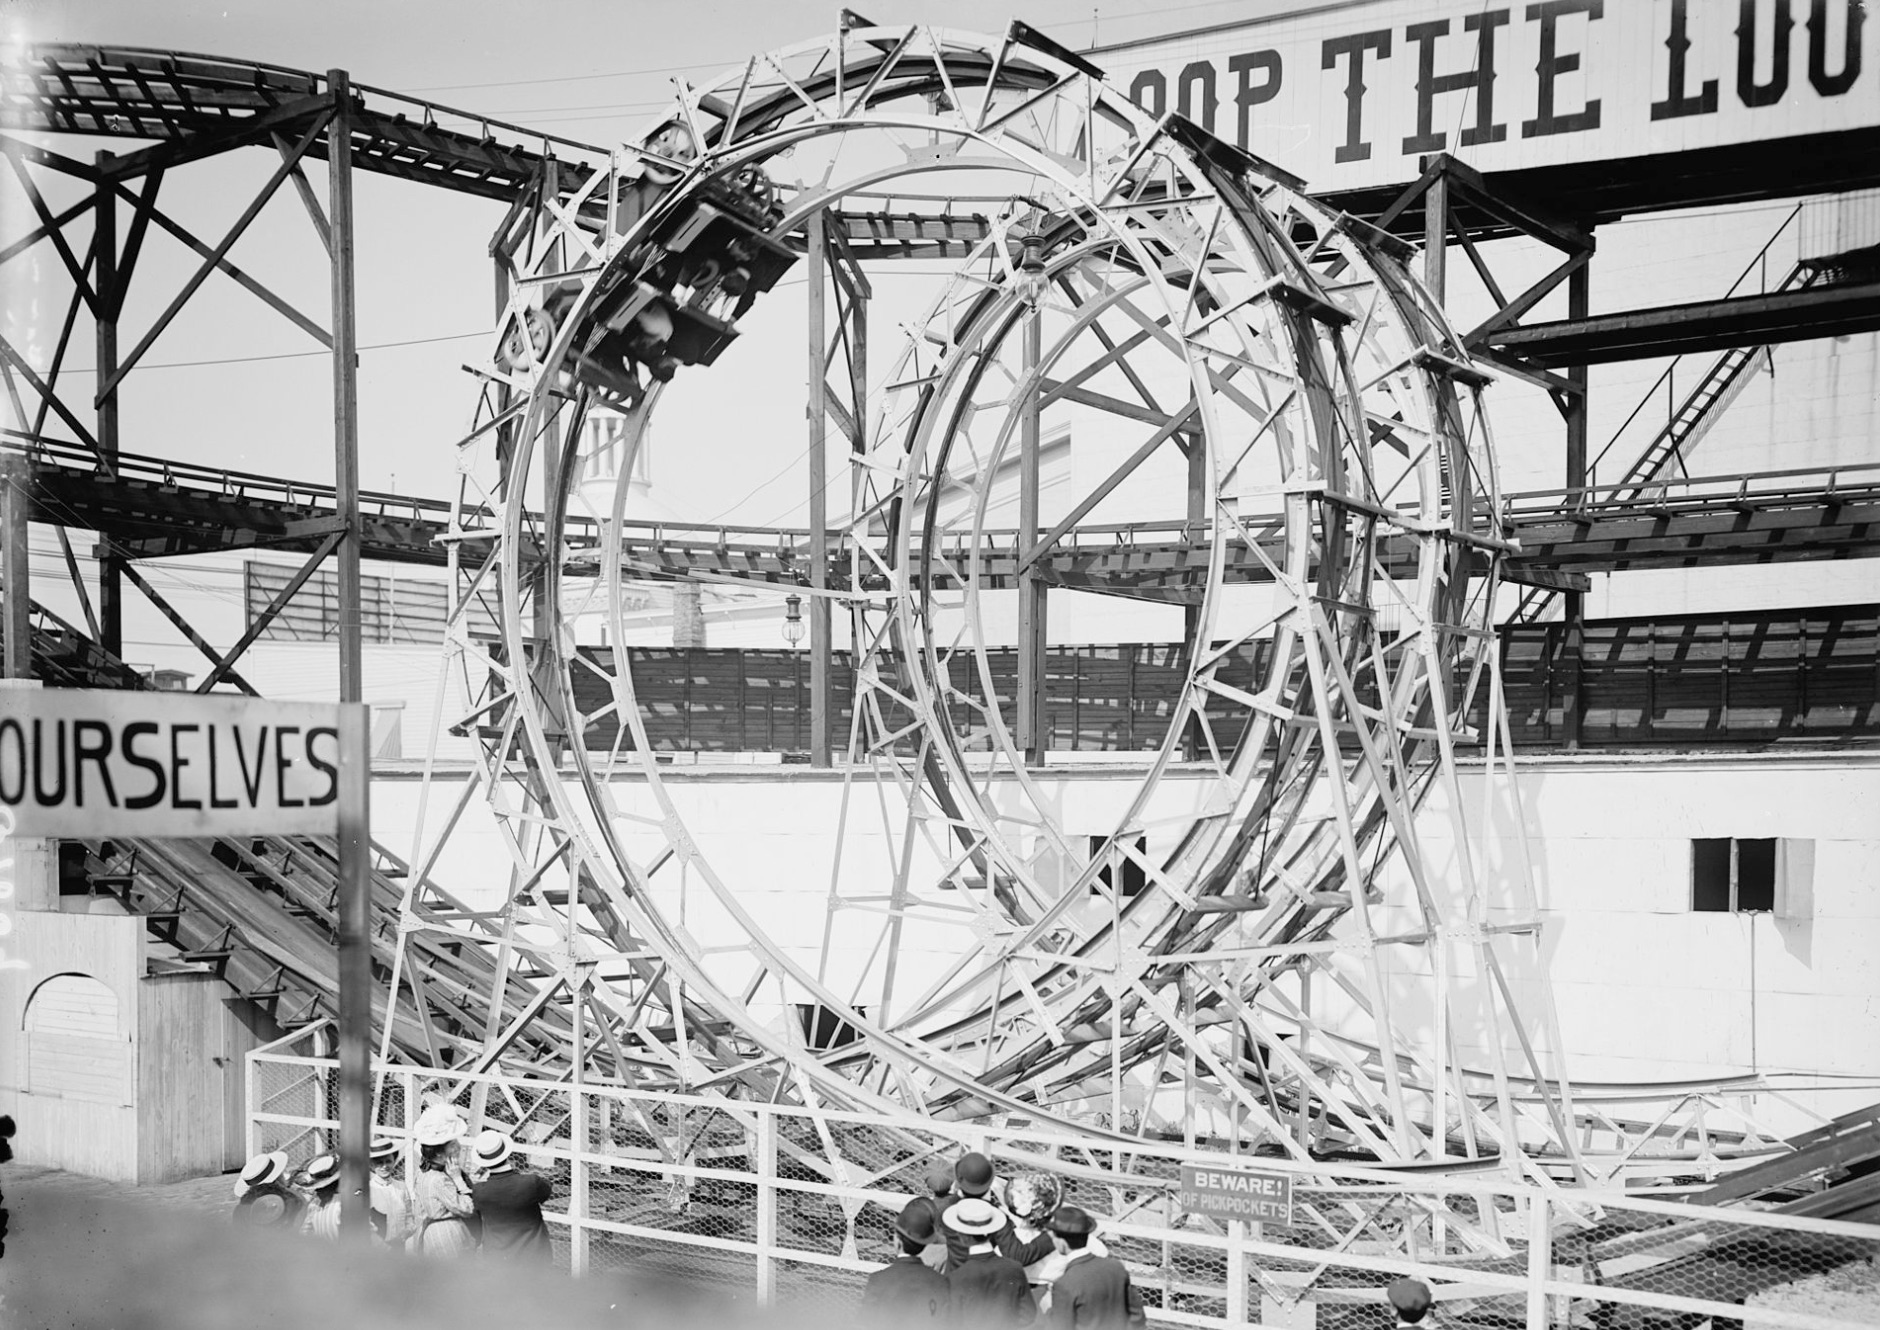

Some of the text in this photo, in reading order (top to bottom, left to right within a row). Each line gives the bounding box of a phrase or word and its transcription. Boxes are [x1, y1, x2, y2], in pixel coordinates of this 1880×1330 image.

[1075, 49, 1283, 160] OOP
[1321, 0, 1604, 164] THE
[0, 718, 339, 810] OURSELVES
[1182, 1191, 1288, 1218] OF PICKPOCKETS
[1195, 1172, 1282, 1196] BEWARE!
